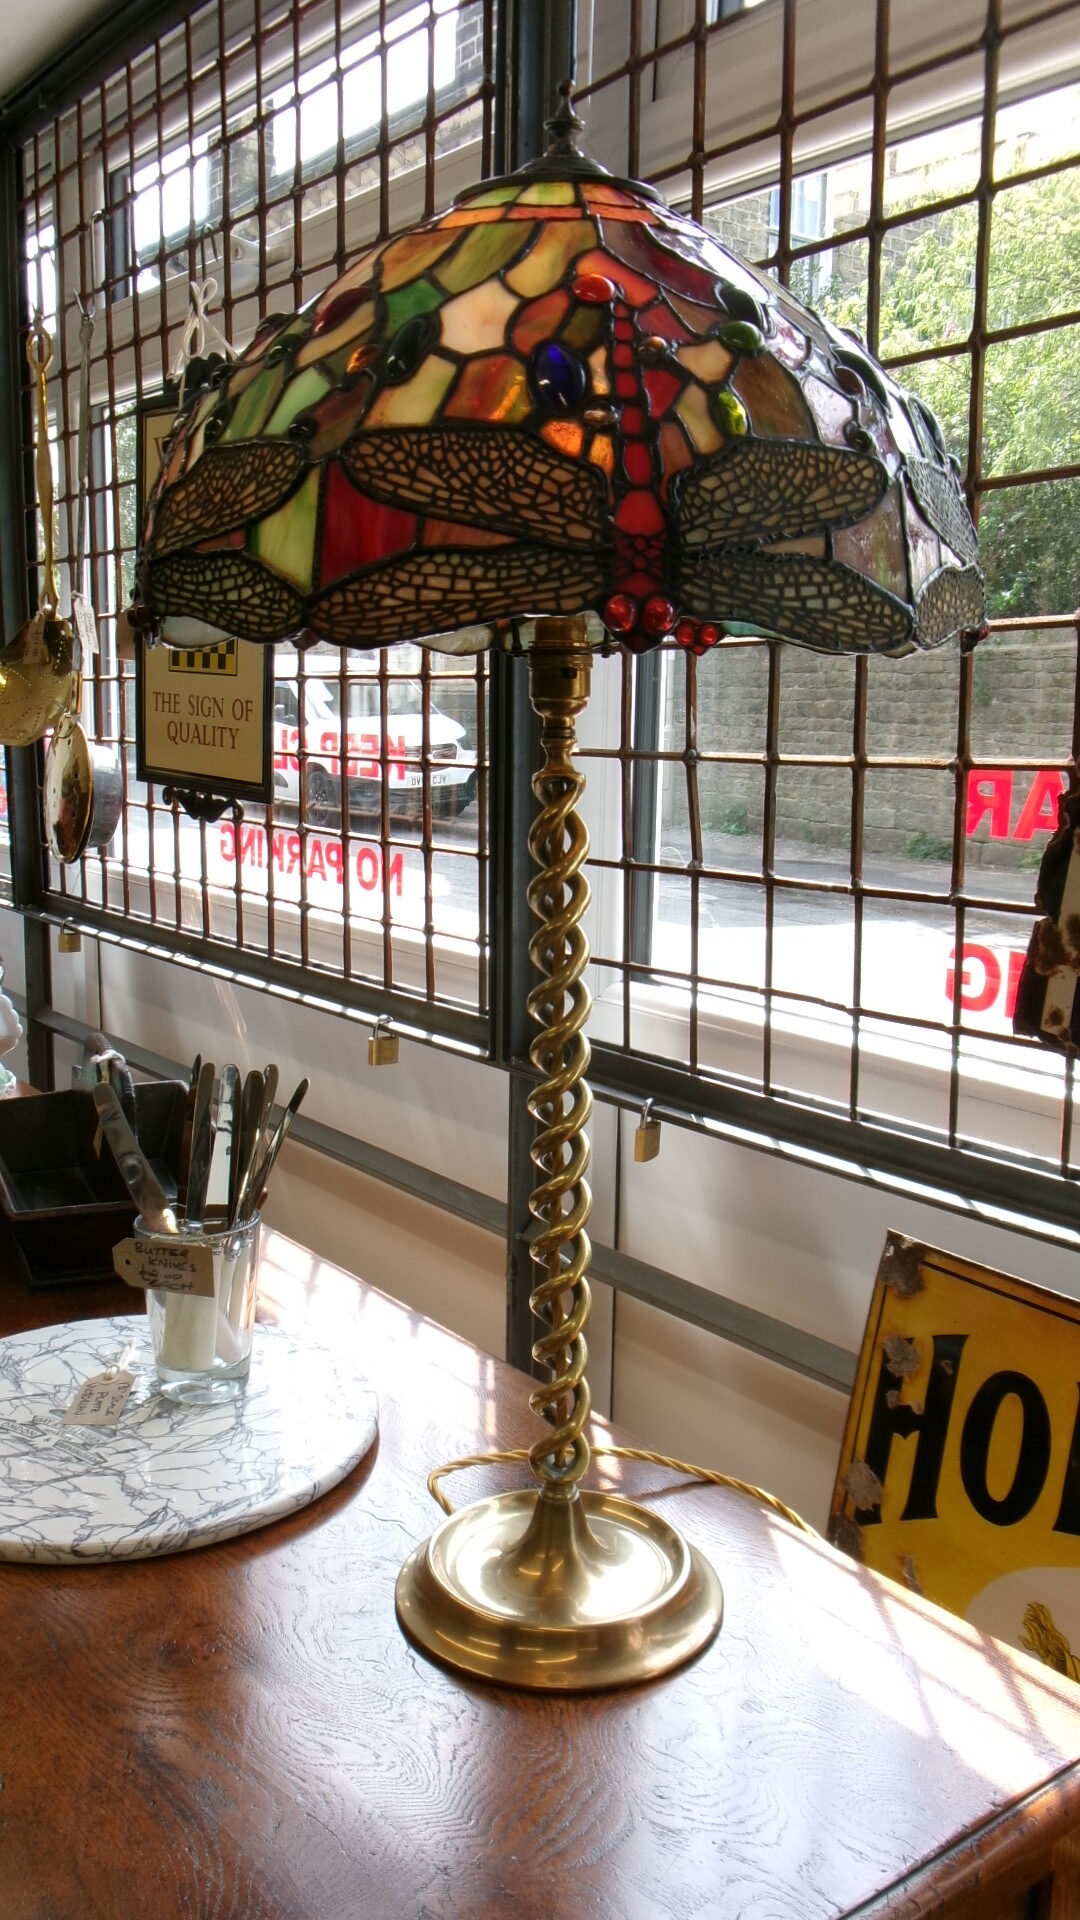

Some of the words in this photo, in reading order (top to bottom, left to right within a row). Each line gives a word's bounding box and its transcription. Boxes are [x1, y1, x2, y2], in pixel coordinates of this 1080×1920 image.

[152, 691, 181, 714] THE
[188, 694, 225, 718] SIGN
[232, 698, 254, 721] OF
[167, 720, 240, 749] QUALITY
[135, 1241, 190, 1258] BUTTER
[148, 1256, 197, 1272] KNIVES
